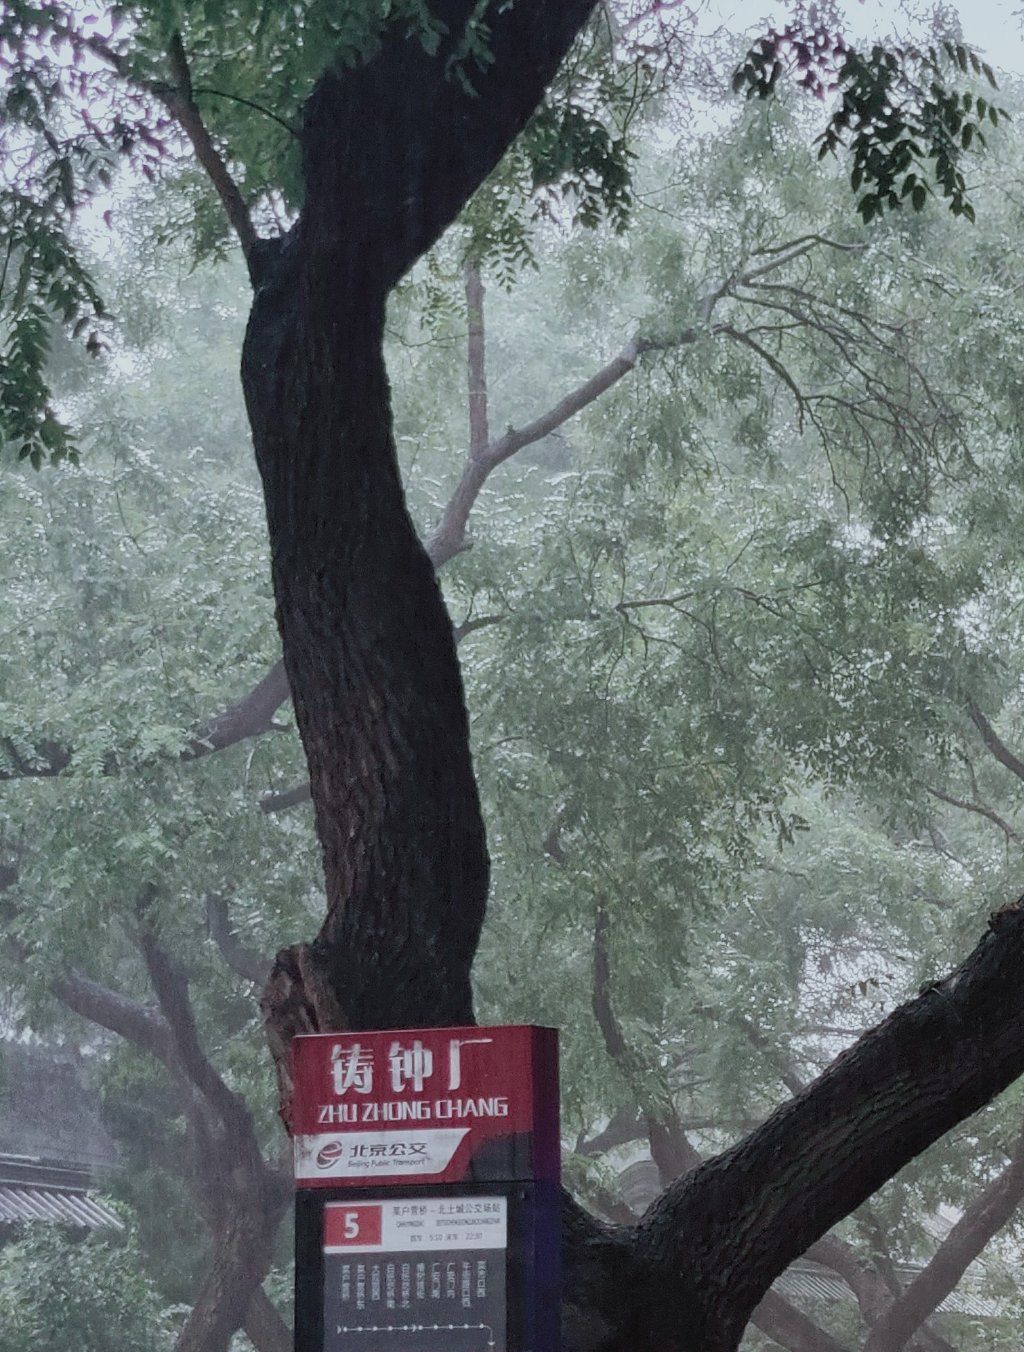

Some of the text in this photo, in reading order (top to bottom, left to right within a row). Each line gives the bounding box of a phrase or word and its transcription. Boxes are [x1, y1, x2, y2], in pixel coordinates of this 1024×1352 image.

[330, 1038, 493, 1096] 铸钟厂
[317, 1097, 509, 1124] ZHU ZHONG CHANG
[349, 1142, 428, 1159] 北京公交
[344, 1213, 360, 1239] 5
